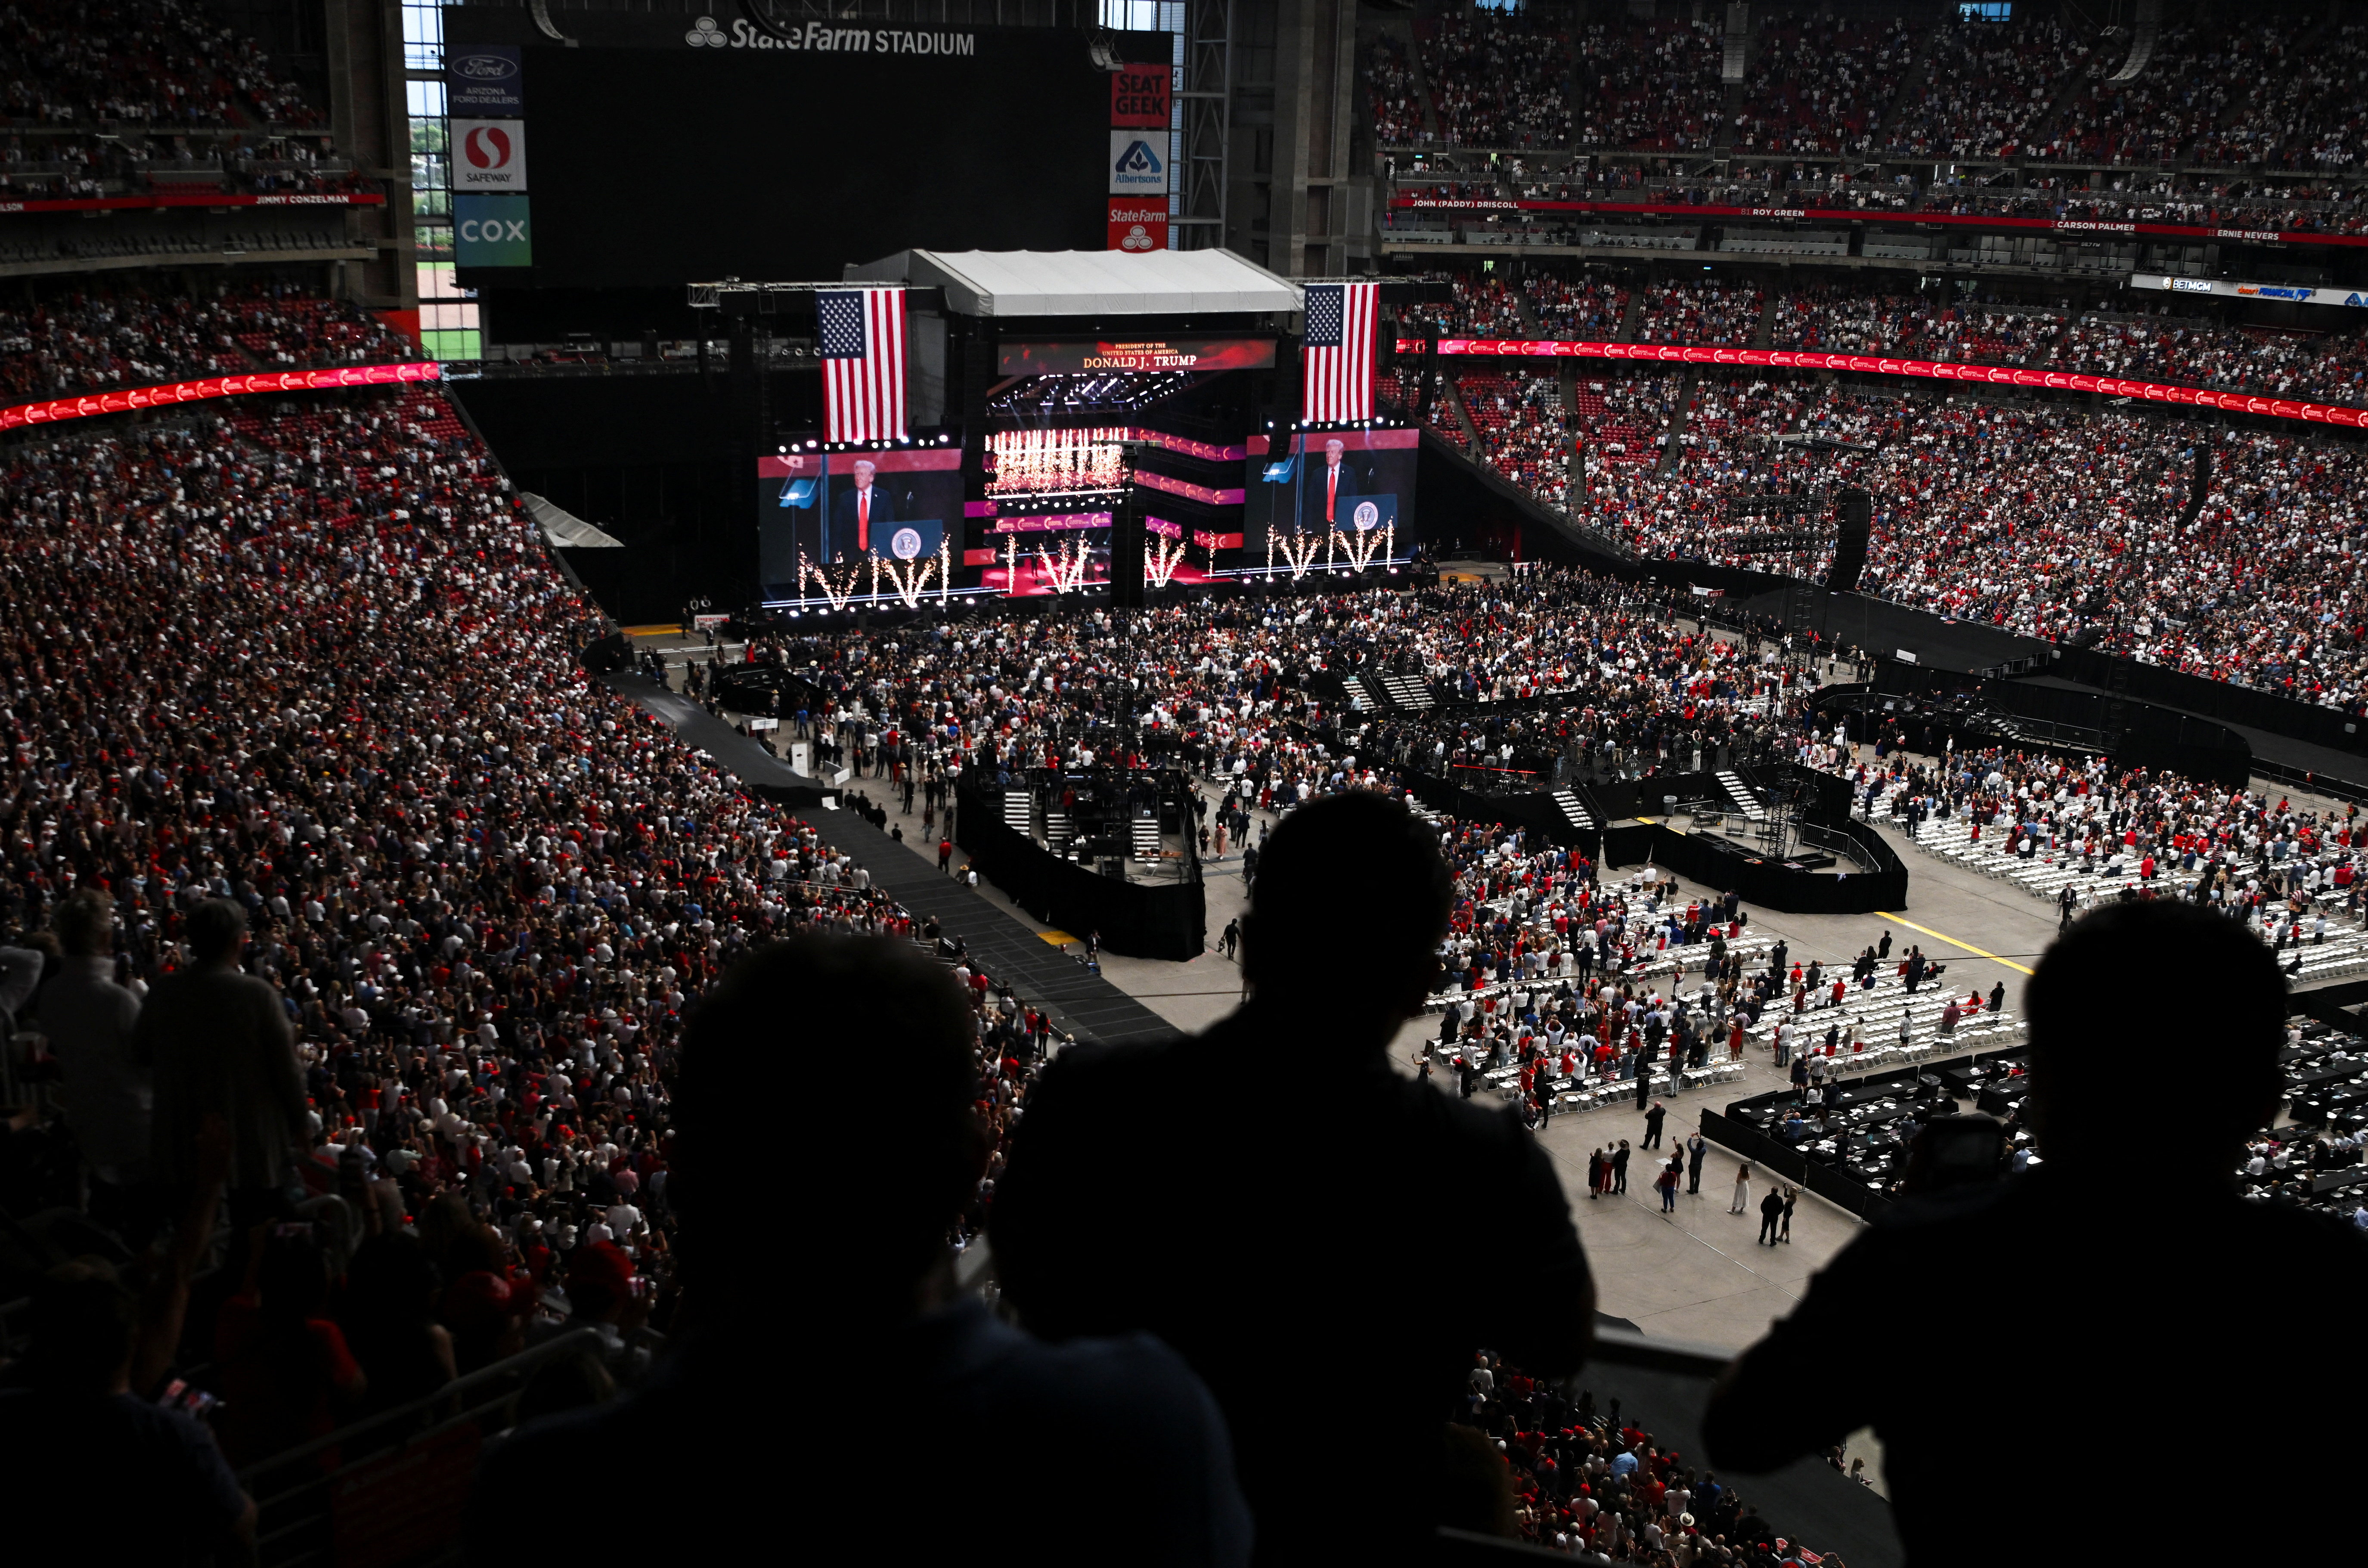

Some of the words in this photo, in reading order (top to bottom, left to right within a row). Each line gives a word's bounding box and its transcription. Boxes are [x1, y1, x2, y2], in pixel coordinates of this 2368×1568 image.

[804, 21, 871, 52] Farm
[874, 30, 974, 56] STADIUM
[465, 59, 505, 76] Ford
[1118, 74, 1165, 94] SEAT
[466, 87, 506, 96] ARIZONA
[453, 95, 478, 103] FORD
[479, 96, 519, 105] DEALERS
[1116, 96, 1165, 116] GEEK
[467, 173, 511, 183] SAFEWAY
[1116, 174, 1162, 183] Albertsons
[255, 195, 287, 205] JIMMY
[289, 195, 349, 204] CONZELMAN
[1438, 200, 1475, 208] (PADDY)
[1110, 209, 1138, 222] State
[1139, 209, 1166, 223] Farm
[461, 220, 526, 242] COX
[2098, 223, 2136, 231] PALMER
[2217, 229, 2242, 238] ERNIE
[2244, 231, 2279, 240] NEVERS
[2173, 280, 2211, 291] BETMGM
[1083, 357, 1136, 369] DONALD
[1138, 357, 1150, 370] J.
[1153, 355, 1196, 366] TRUMP
